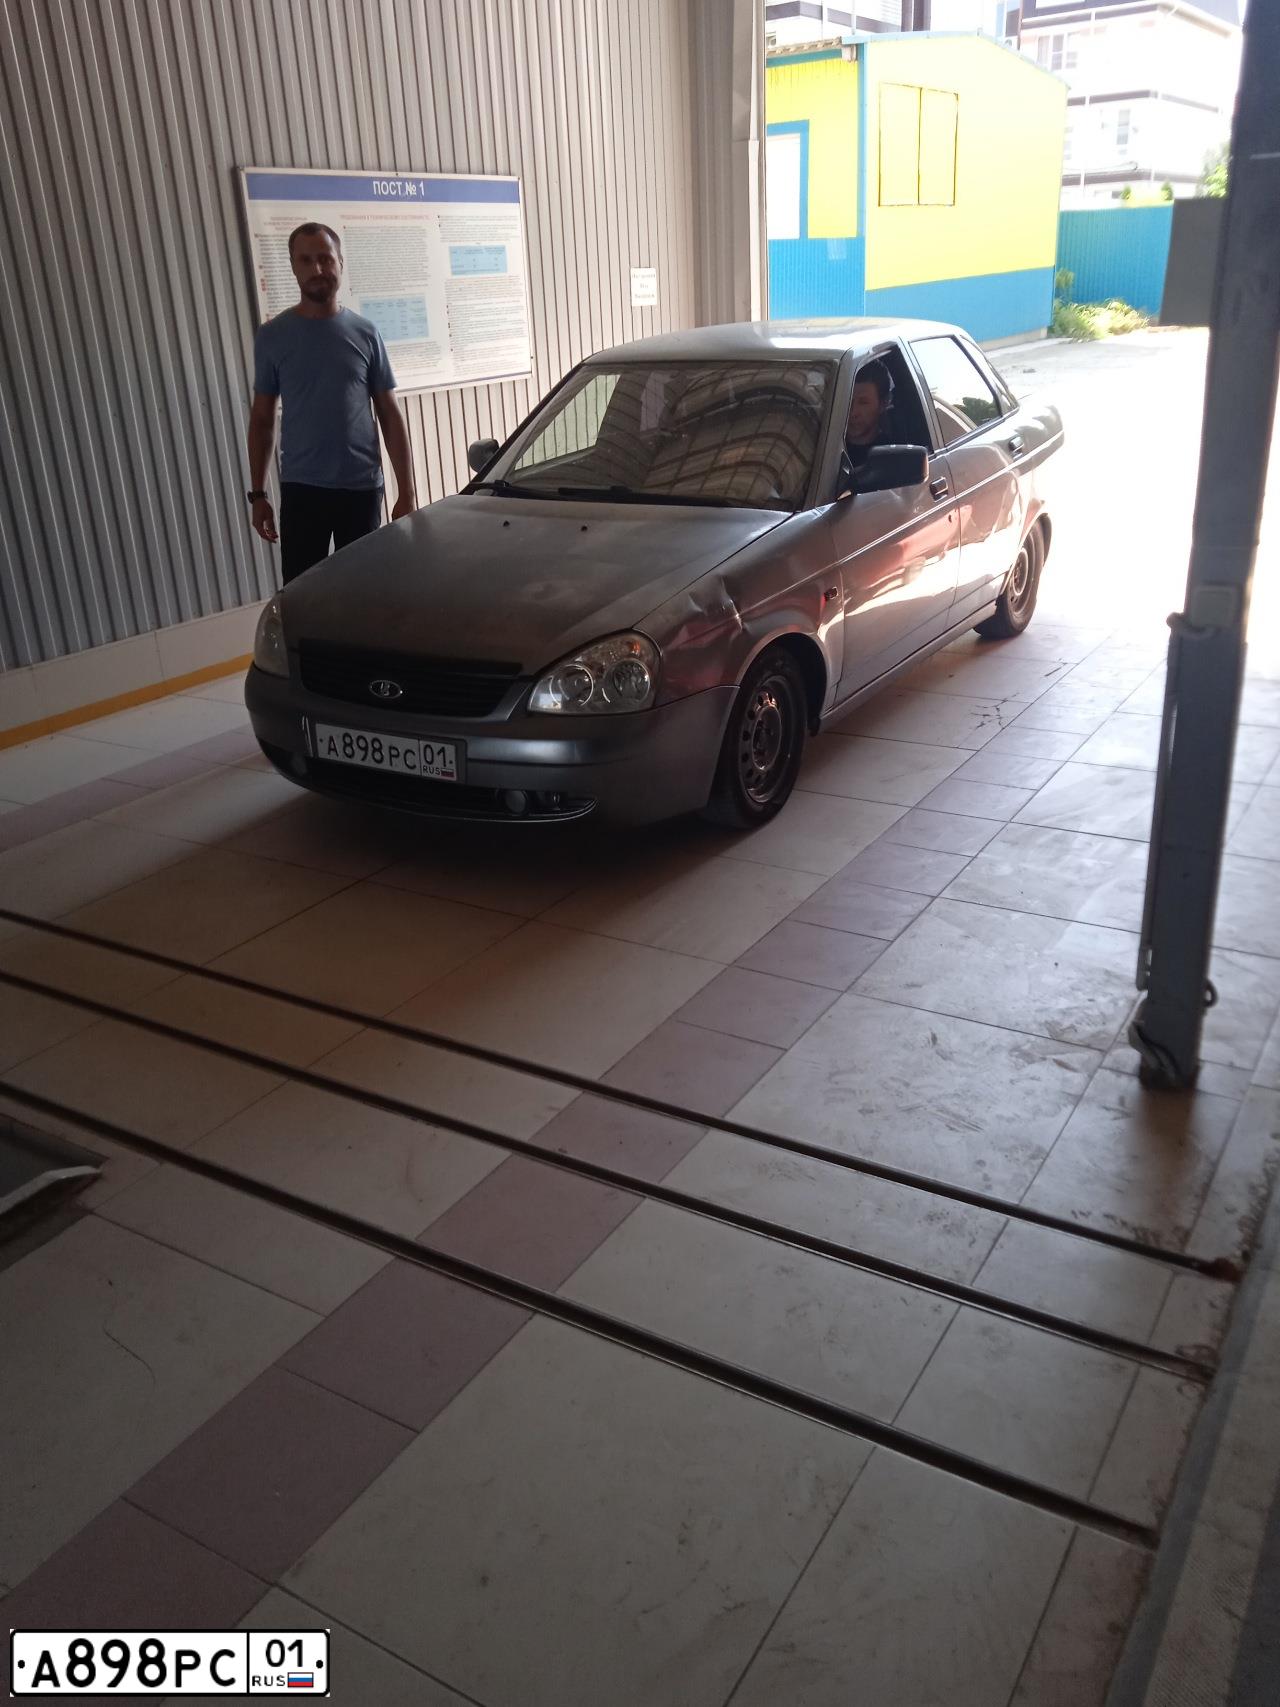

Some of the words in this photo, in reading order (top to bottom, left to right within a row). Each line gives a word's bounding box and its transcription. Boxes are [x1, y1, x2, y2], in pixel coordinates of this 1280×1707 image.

[373, 181, 402, 196] ПОСТ
[405, 181, 417, 196] №
[419, 181, 425, 197] 1
[328, 732, 417, 770] А898РС
[423, 744, 447, 767] 01
[423, 765, 441, 776] RUS
